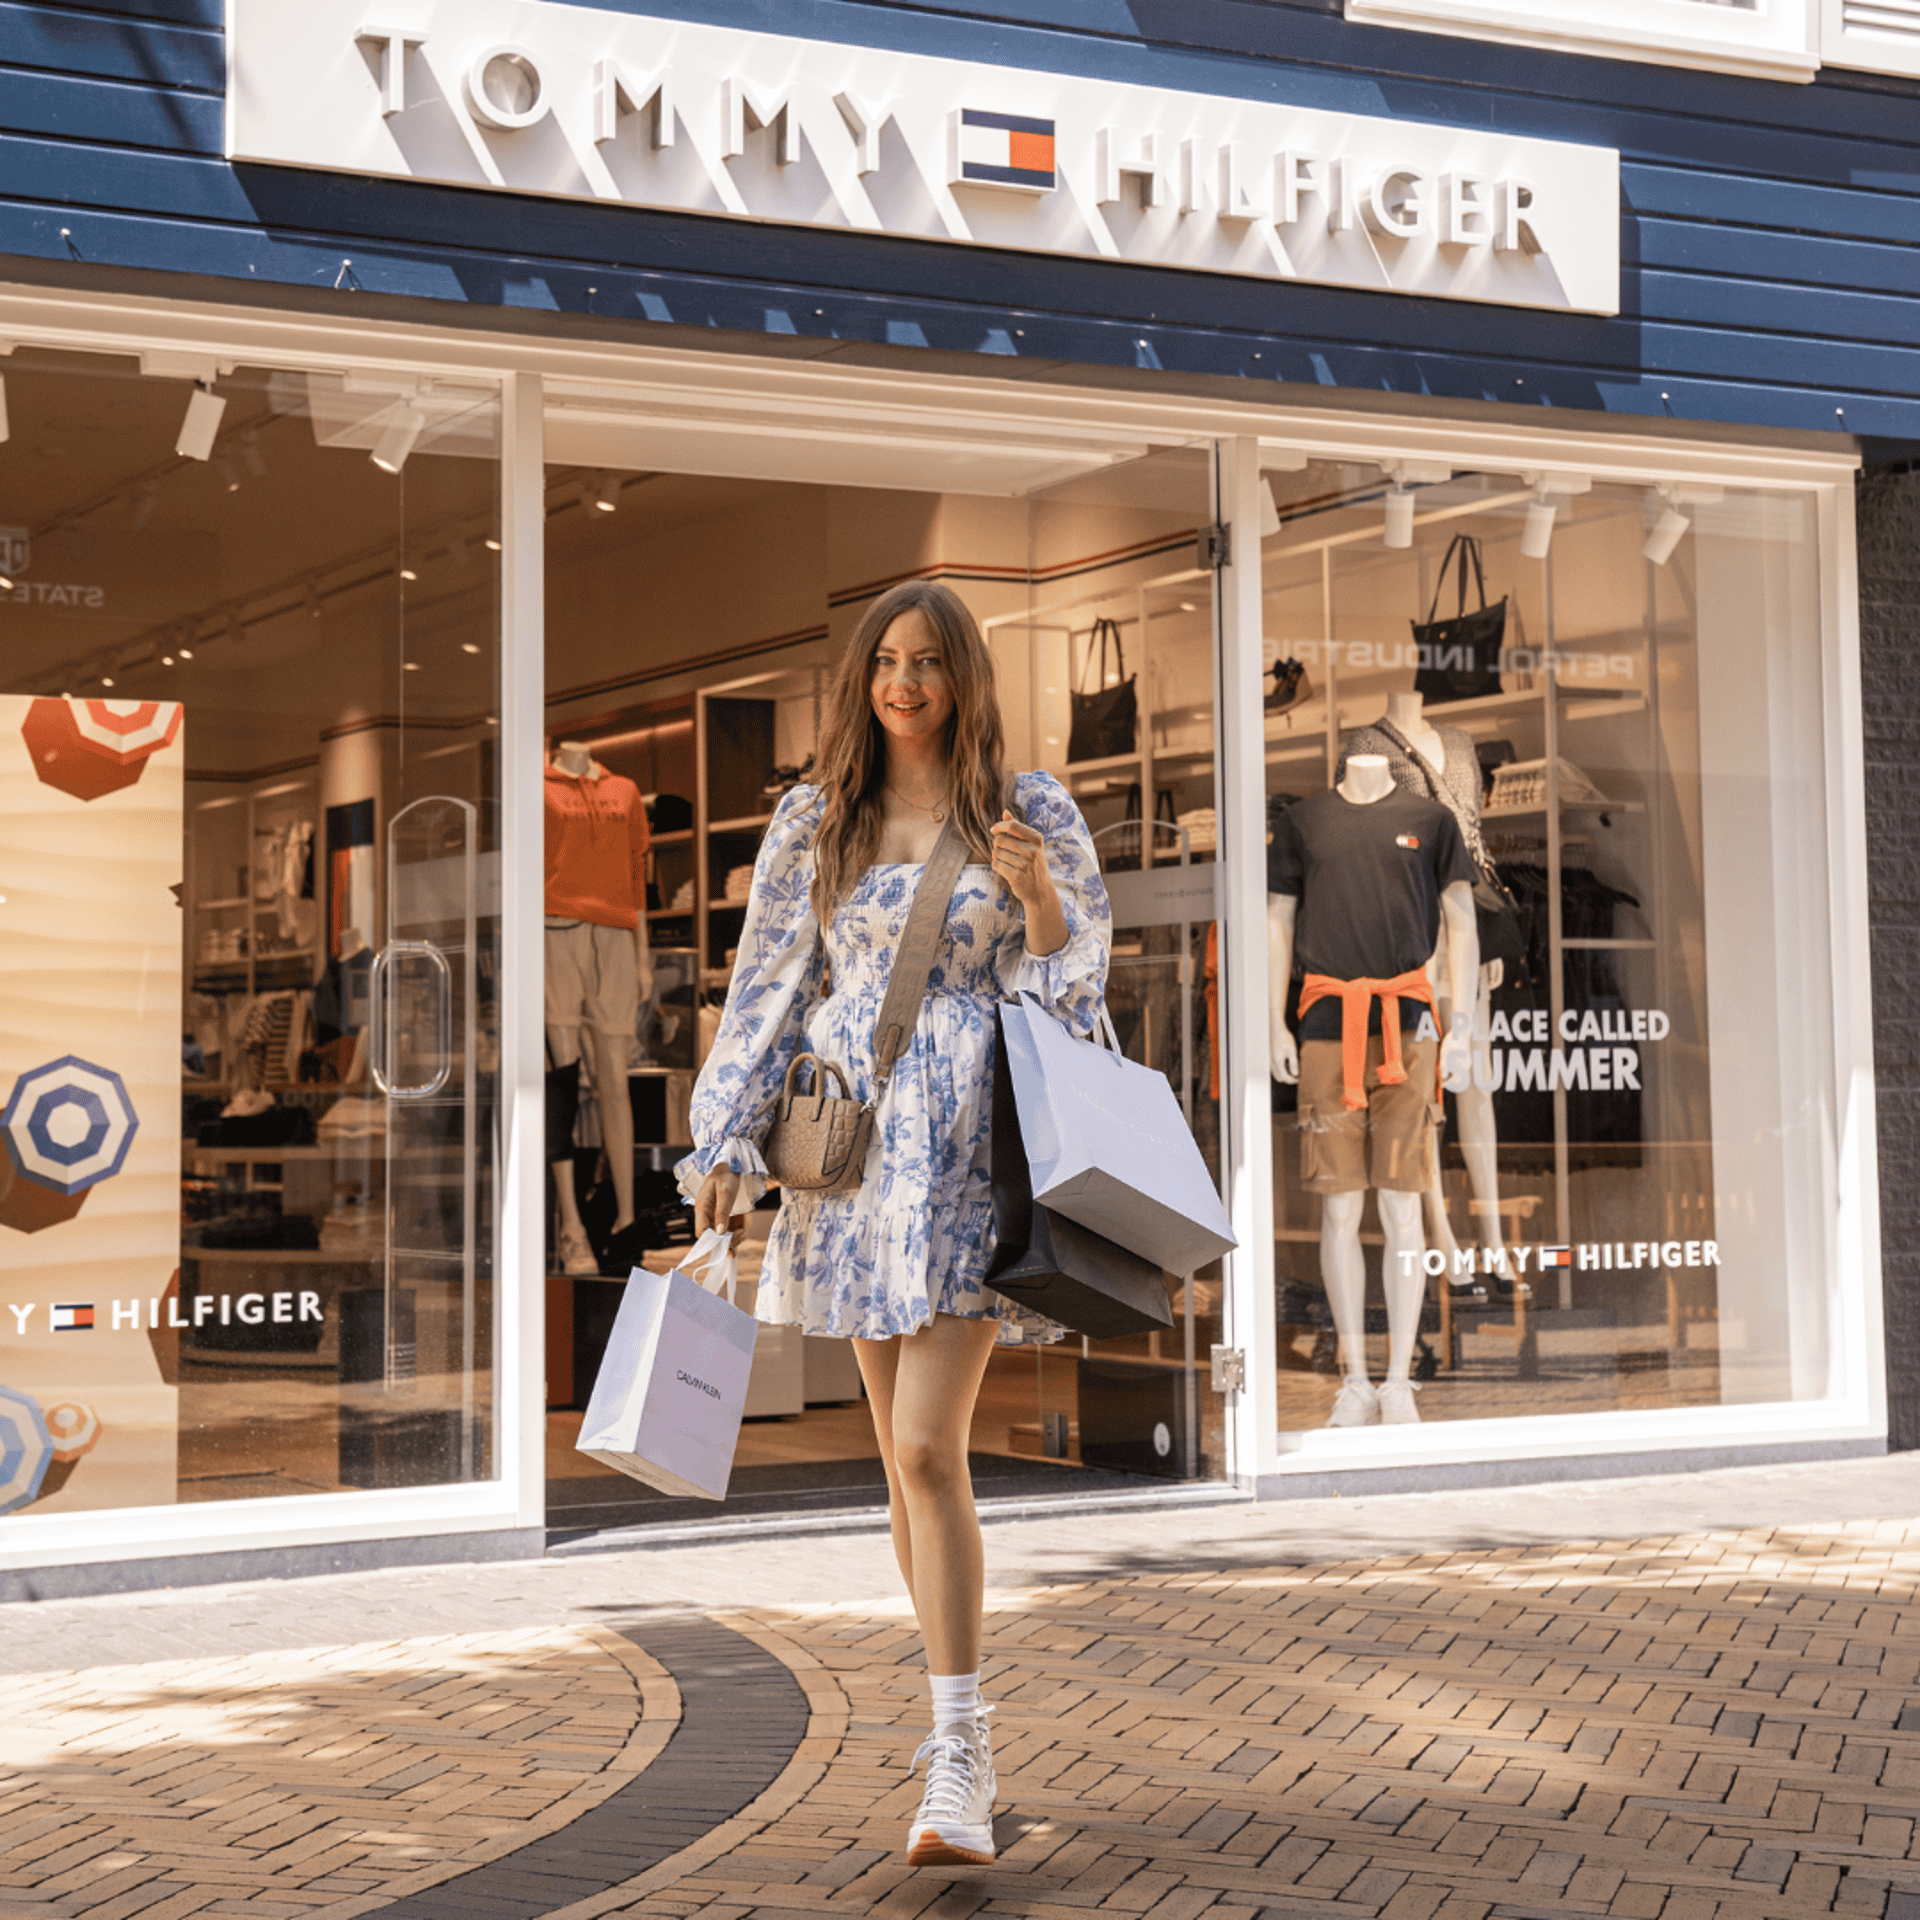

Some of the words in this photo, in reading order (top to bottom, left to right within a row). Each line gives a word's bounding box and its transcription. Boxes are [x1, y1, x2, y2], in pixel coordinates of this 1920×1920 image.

[353, 25, 903, 176] TOMMY
[1096, 125, 1547, 254] HILFIGER
[1414, 1010, 1440, 1042] A
[1451, 1010, 1549, 1042] PLACE
[1558, 1009, 1670, 1042] CALLED
[1441, 1047, 1642, 1094] SUMMER
[1397, 1246, 1532, 1276] TOMMY
[1577, 1240, 1722, 1271] HILFIGER
[111, 1290, 324, 1330] HILFIGER
[702, 1382, 722, 1400] KLEIN
